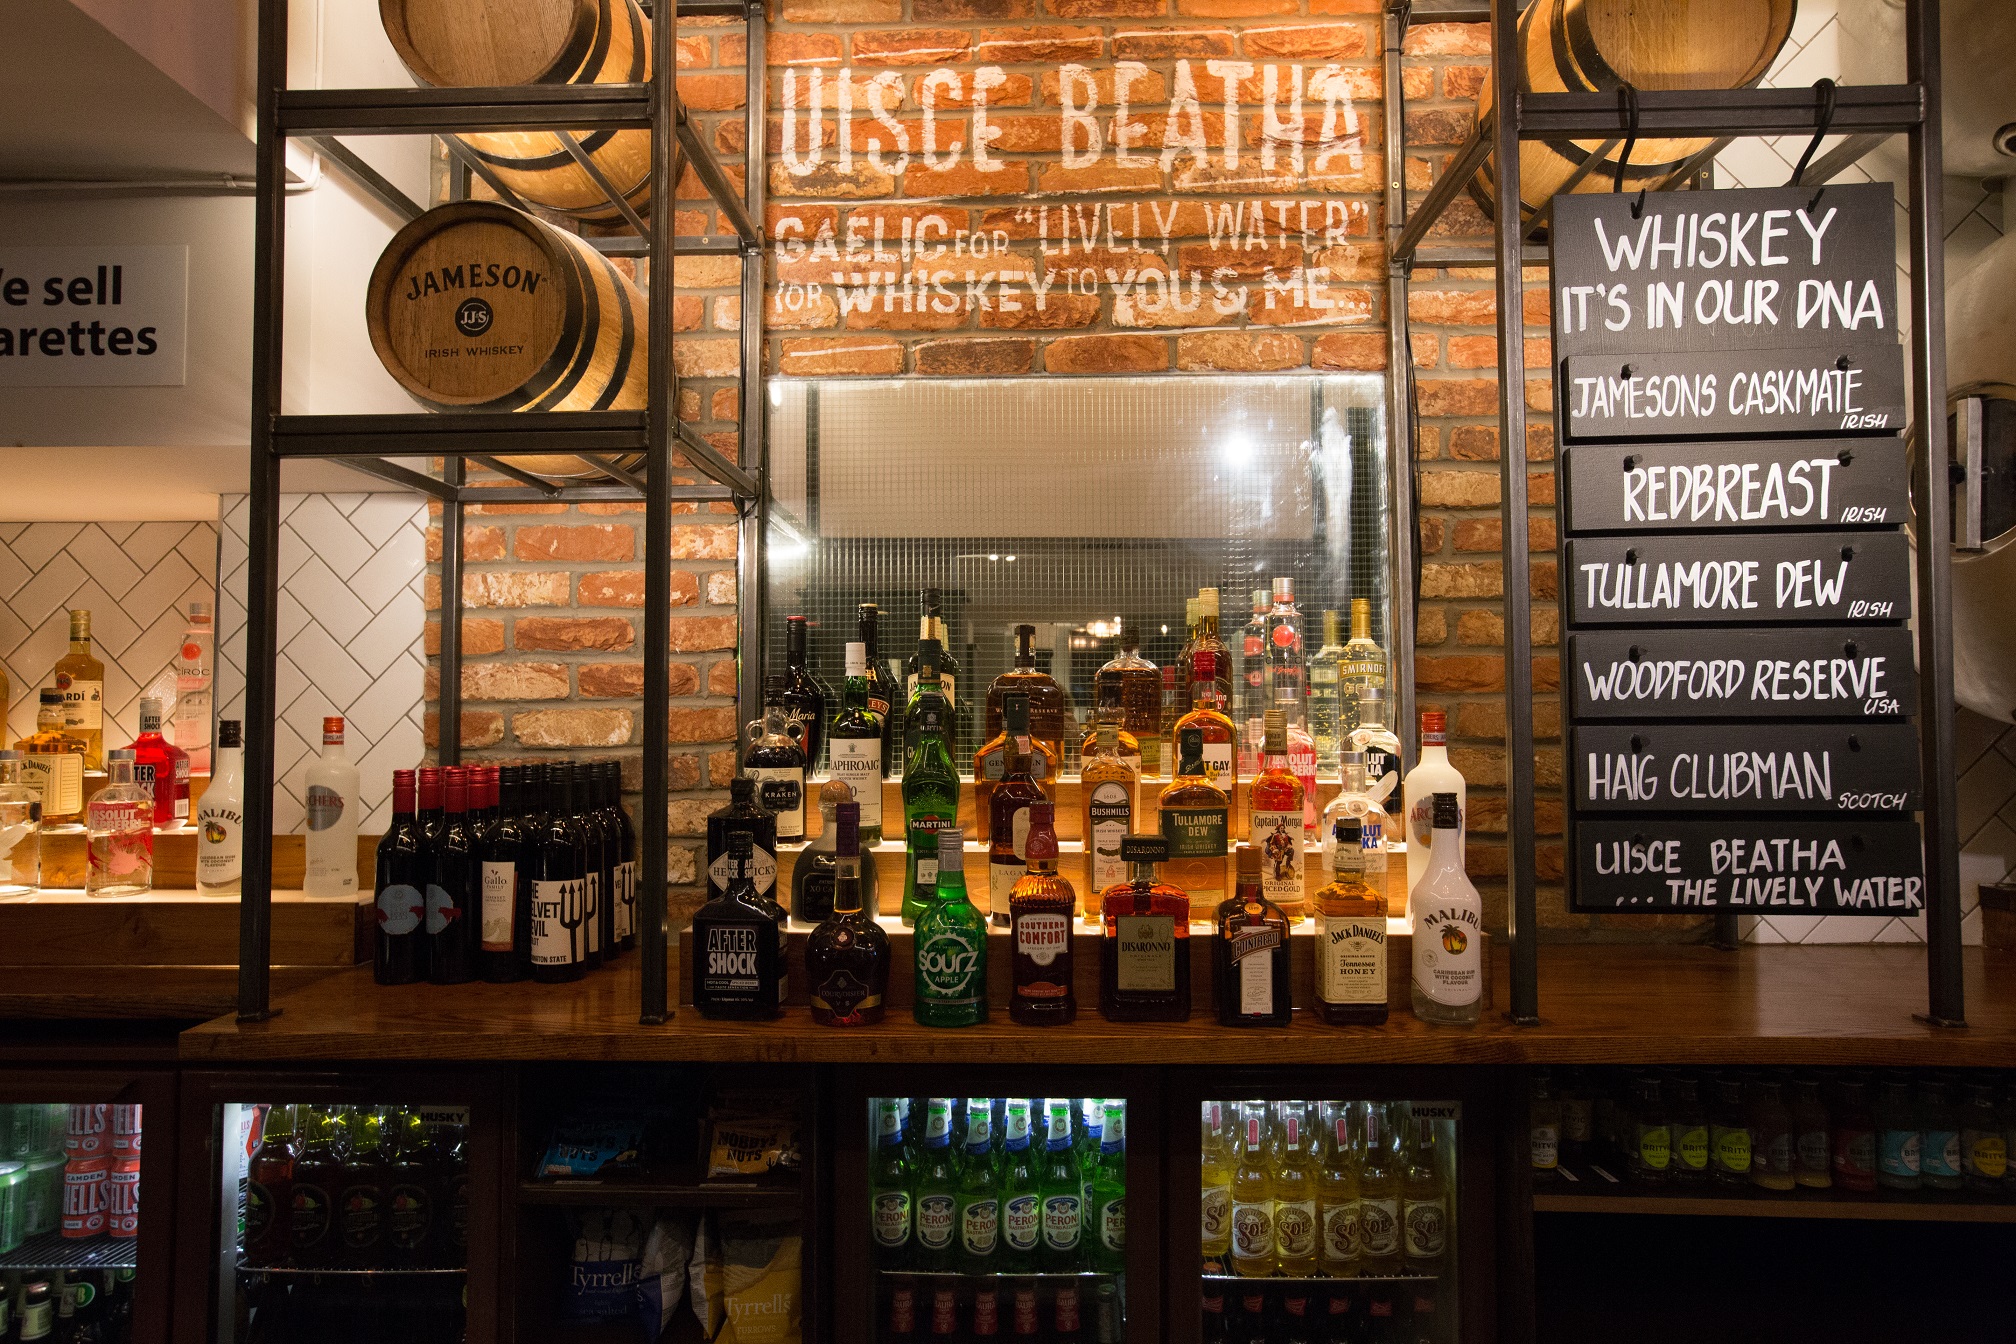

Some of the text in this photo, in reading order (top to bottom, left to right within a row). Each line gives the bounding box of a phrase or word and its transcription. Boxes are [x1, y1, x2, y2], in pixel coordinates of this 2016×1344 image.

[782, 59, 1364, 177] UISCE BEATHA
[774, 215, 949, 264] GAELIC
[954, 229, 1010, 260] FOR
[1593, 206, 1838, 272] WHISKEY
[0, 265, 122, 306] e sell
[406, 264, 541, 301] JAMESON
[836, 268, 1057, 317] WHISKEY
[1065, 268, 1100, 297] TO
[1105, 267, 1202, 314] YOU
[1210, 267, 1249, 315] &
[1561, 279, 1885, 334] IT'S IN OUR DNA
[425, 345, 525, 359] IRISH WHISKEY
[1571, 368, 1864, 418] JAMESONS CASKMATE
[1840, 413, 1889, 430] IRISH
[1623, 458, 1840, 523] REDBREAST
[1840, 507, 1888, 524] IRISH
[1580, 560, 1849, 610] TULLAMORE DEW
[1847, 600, 1894, 618] IRISH
[1342, 664, 1386, 676] SMIRNOFF
[1583, 656, 1889, 701] WOODFORD RESERVE
[909, 681, 951, 692] JAON
[789, 707, 817, 721] Maria
[868, 699, 888, 712] EYS
[1862, 698, 1900, 715] USA
[134, 765, 155, 782] TER
[1213, 760, 1230, 771] GAY
[1291, 765, 1316, 776] BERRI
[1588, 750, 1832, 802] HAIG CLUBMAN
[1837, 792, 1907, 811] SCOTCH
[1091, 807, 1130, 816] BUSHMILLS
[1172, 812, 1223, 826] TULLAMORE
[911, 820, 951, 829] MARTINI
[1255, 815, 1303, 829] Captain Morgan
[1188, 826, 1209, 837] DEW
[1126, 845, 1166, 855] DISARONNO
[1595, 838, 1847, 876] UISCE BEATHA
[484, 874, 507, 885] Gallo
[713, 865, 776, 877] HEICK'S
[1263, 885, 1301, 893] PICED GOLD
[1666, 878, 1719, 906] THE
[1729, 877, 1824, 907] LIVELY
[1833, 877, 1925, 910] WATER
[532, 902, 561, 918] ELVET
[532, 919, 549, 937] EVIL
[1020, 921, 1065, 930] SOUTHERN
[1424, 908, 1480, 931] MALIBU
[707, 928, 757, 951] AFTER
[1020, 930, 1066, 945] COMFORT
[1331, 924, 1385, 945] JACK DANIEL'S
[1121, 941, 1171, 952] DISARONNO
[1233, 932, 1280, 958] COINTREAU
[549, 955, 567, 963] STATE
[708, 952, 757, 975] SHOCK
[1340, 958, 1375, 968] Tennessee
[934, 975, 959, 983] APPLE
[421, 1112, 466, 1123] HUSKY
[1412, 1107, 1456, 1117] HUSKY
[726, 1149, 763, 1163] NUTS
[67, 1172, 104, 1182] CAMDEN
[63, 1180, 111, 1216] HELLS
[966, 1218, 998, 1230] PERON
[1008, 1214, 1038, 1227] PERON
[1205, 1204, 1227, 1233] SO
[1237, 1220, 1268, 1250] SOL
[1278, 1219, 1311, 1250] SOL
[1334, 1222, 1359, 1251] SO
[1360, 1217, 1391, 1248] SOL
[1412, 1219, 1443, 1251] SOL
[736, 1324, 777, 1336] FURROWS
